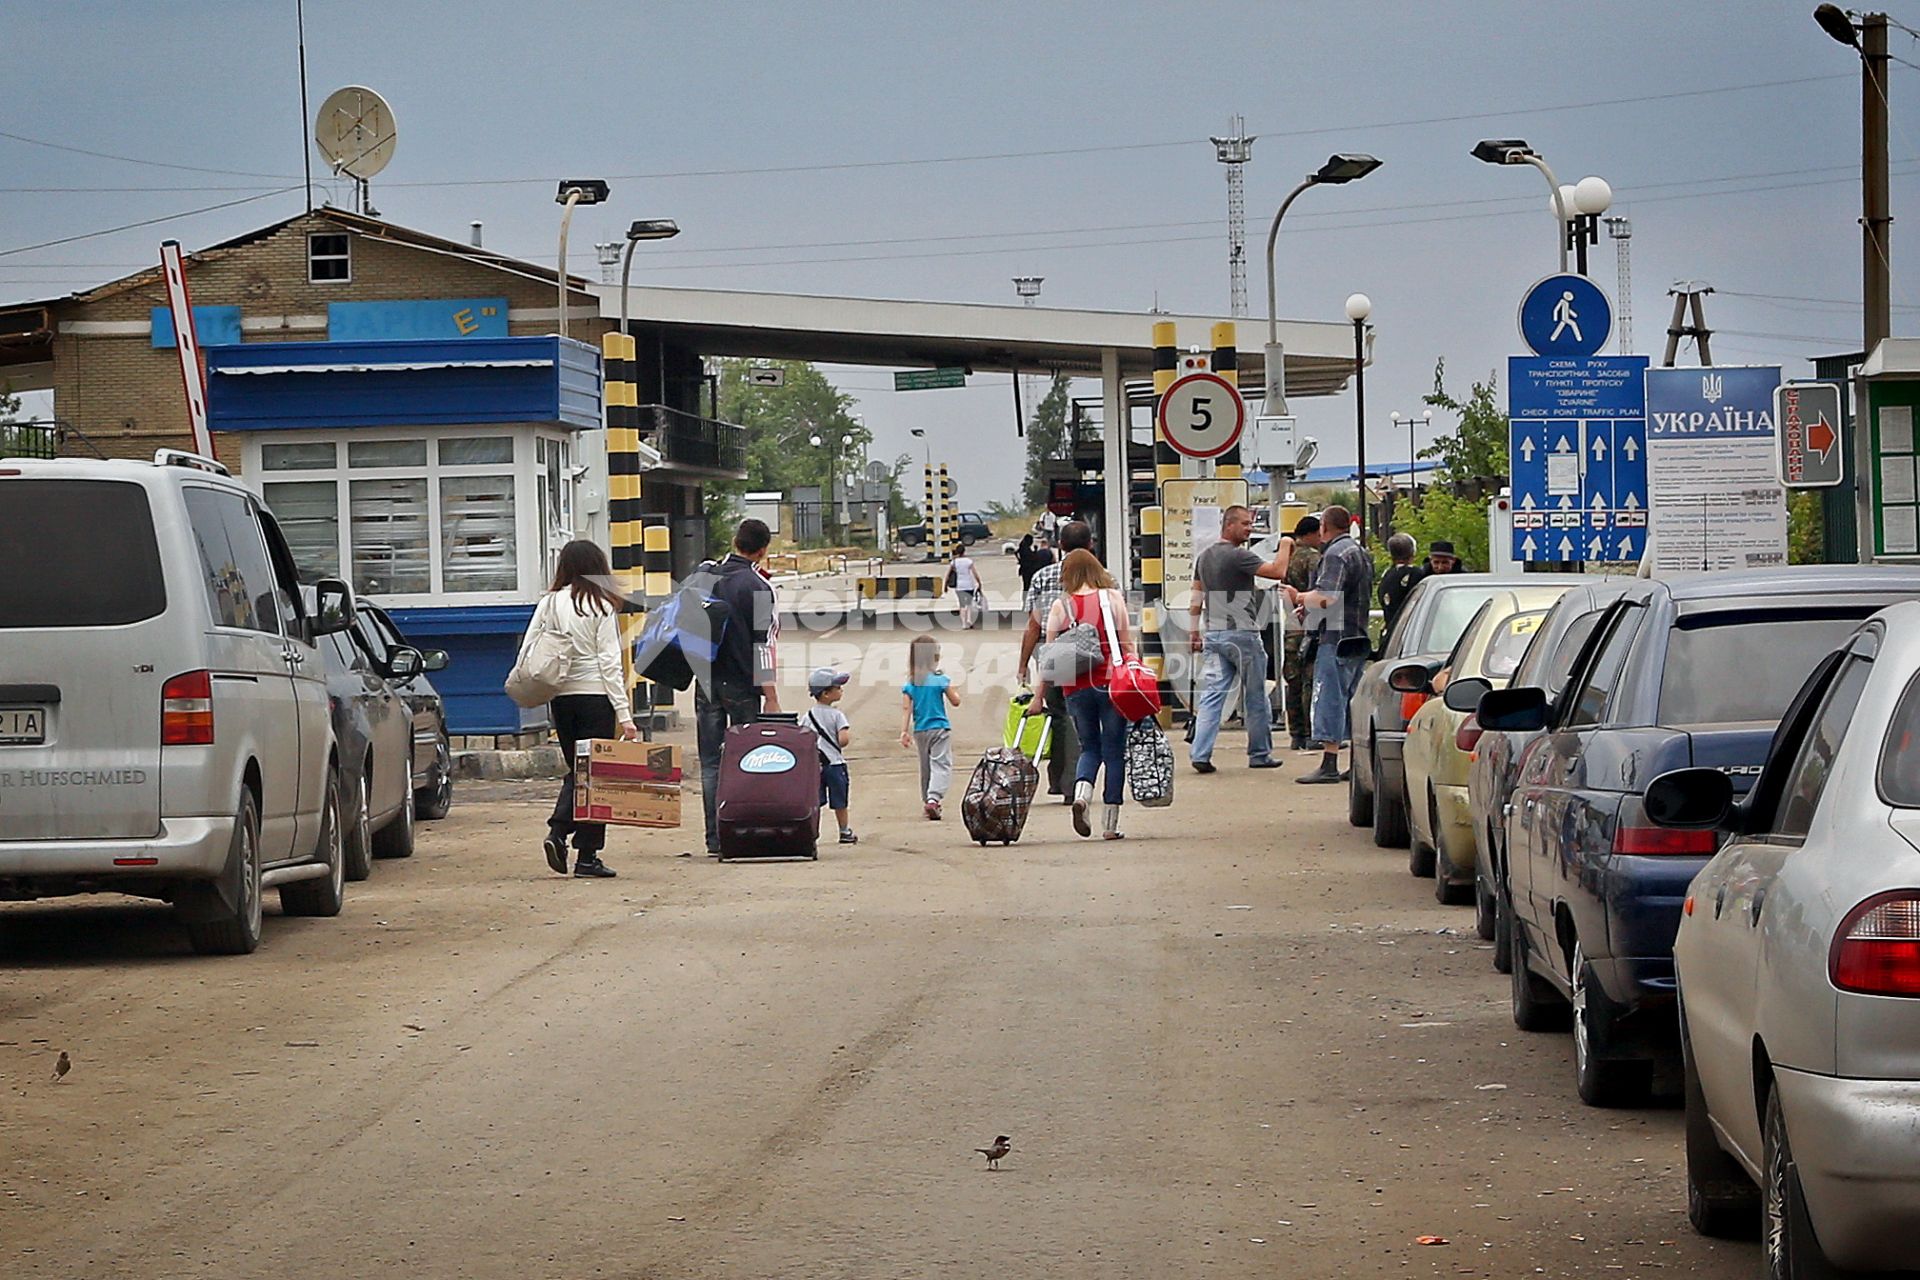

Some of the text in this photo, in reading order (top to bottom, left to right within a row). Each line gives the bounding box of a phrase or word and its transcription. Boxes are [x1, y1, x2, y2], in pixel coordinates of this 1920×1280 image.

[1528, 370, 1590, 378] ТРАНСПОРТНИХ
[1190, 398, 1212, 431] 5
[1652, 406, 1775, 433] УКРАЇНА
[746, 751, 790, 768] Milka
